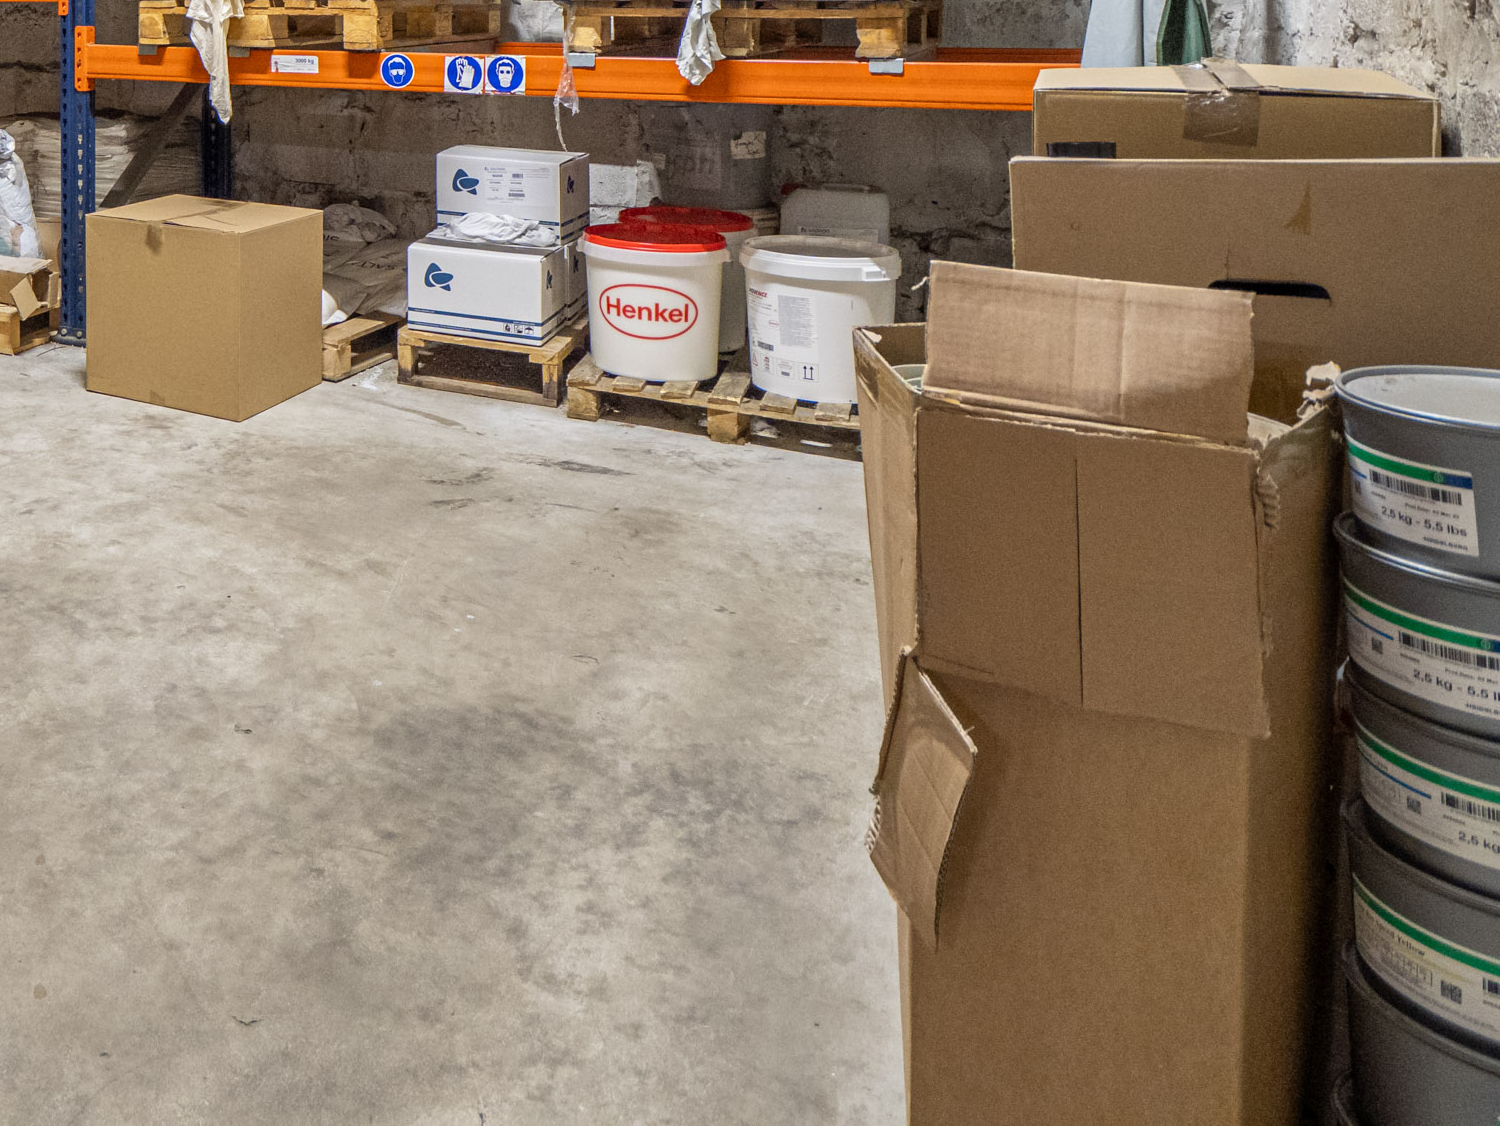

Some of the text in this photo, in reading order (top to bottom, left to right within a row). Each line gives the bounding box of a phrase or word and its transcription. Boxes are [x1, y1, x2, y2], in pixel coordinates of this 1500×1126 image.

[605, 295, 689, 324] Henkel
[1398, 511, 1412, 526] kg
[1447, 524, 1467, 537] lbs
[1436, 676, 1452, 692] kg
